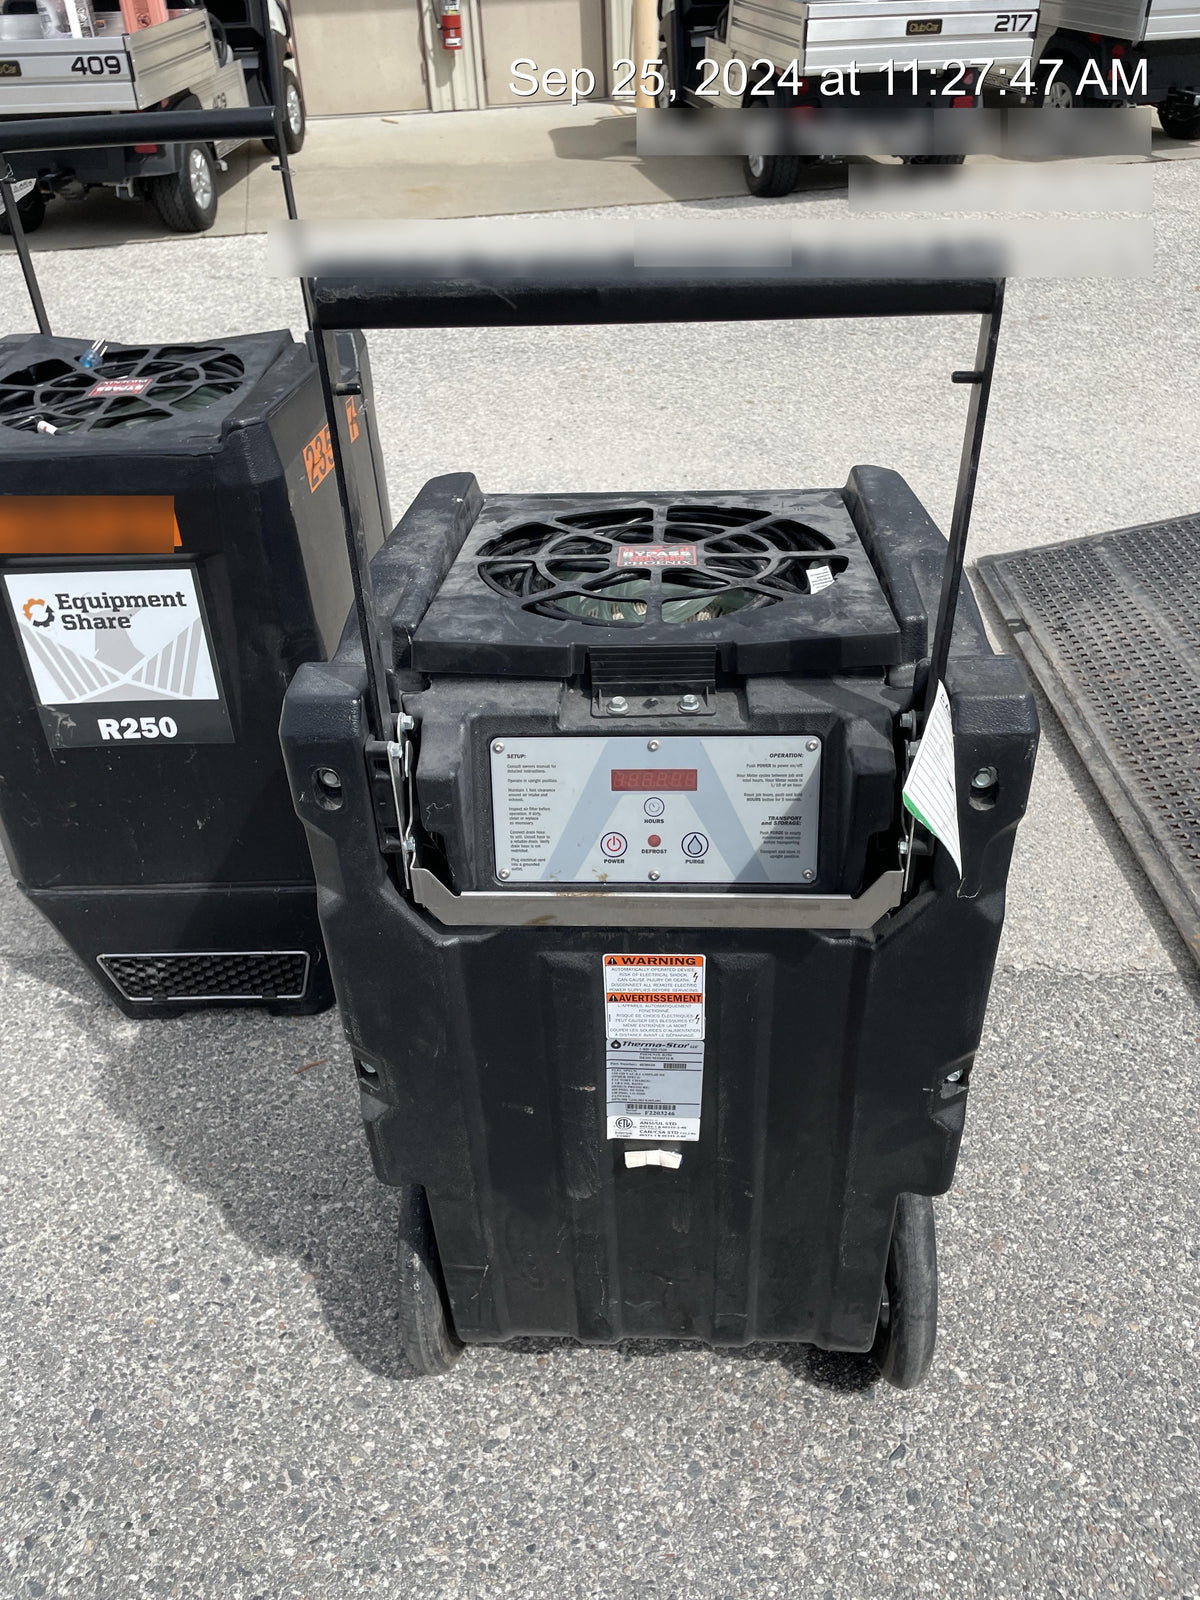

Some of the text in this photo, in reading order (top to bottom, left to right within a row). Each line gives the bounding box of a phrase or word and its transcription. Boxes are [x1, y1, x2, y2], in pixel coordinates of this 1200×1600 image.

[994, 14, 1033, 32] 217
[71, 55, 121, 75] 409
[55, 591, 187, 612] Equipment
[61, 613, 132, 631] Share
[97, 716, 178, 740] R250
[622, 957, 696, 965] WARNING
[623, 1041, 689, 1049] Therma-Stor
